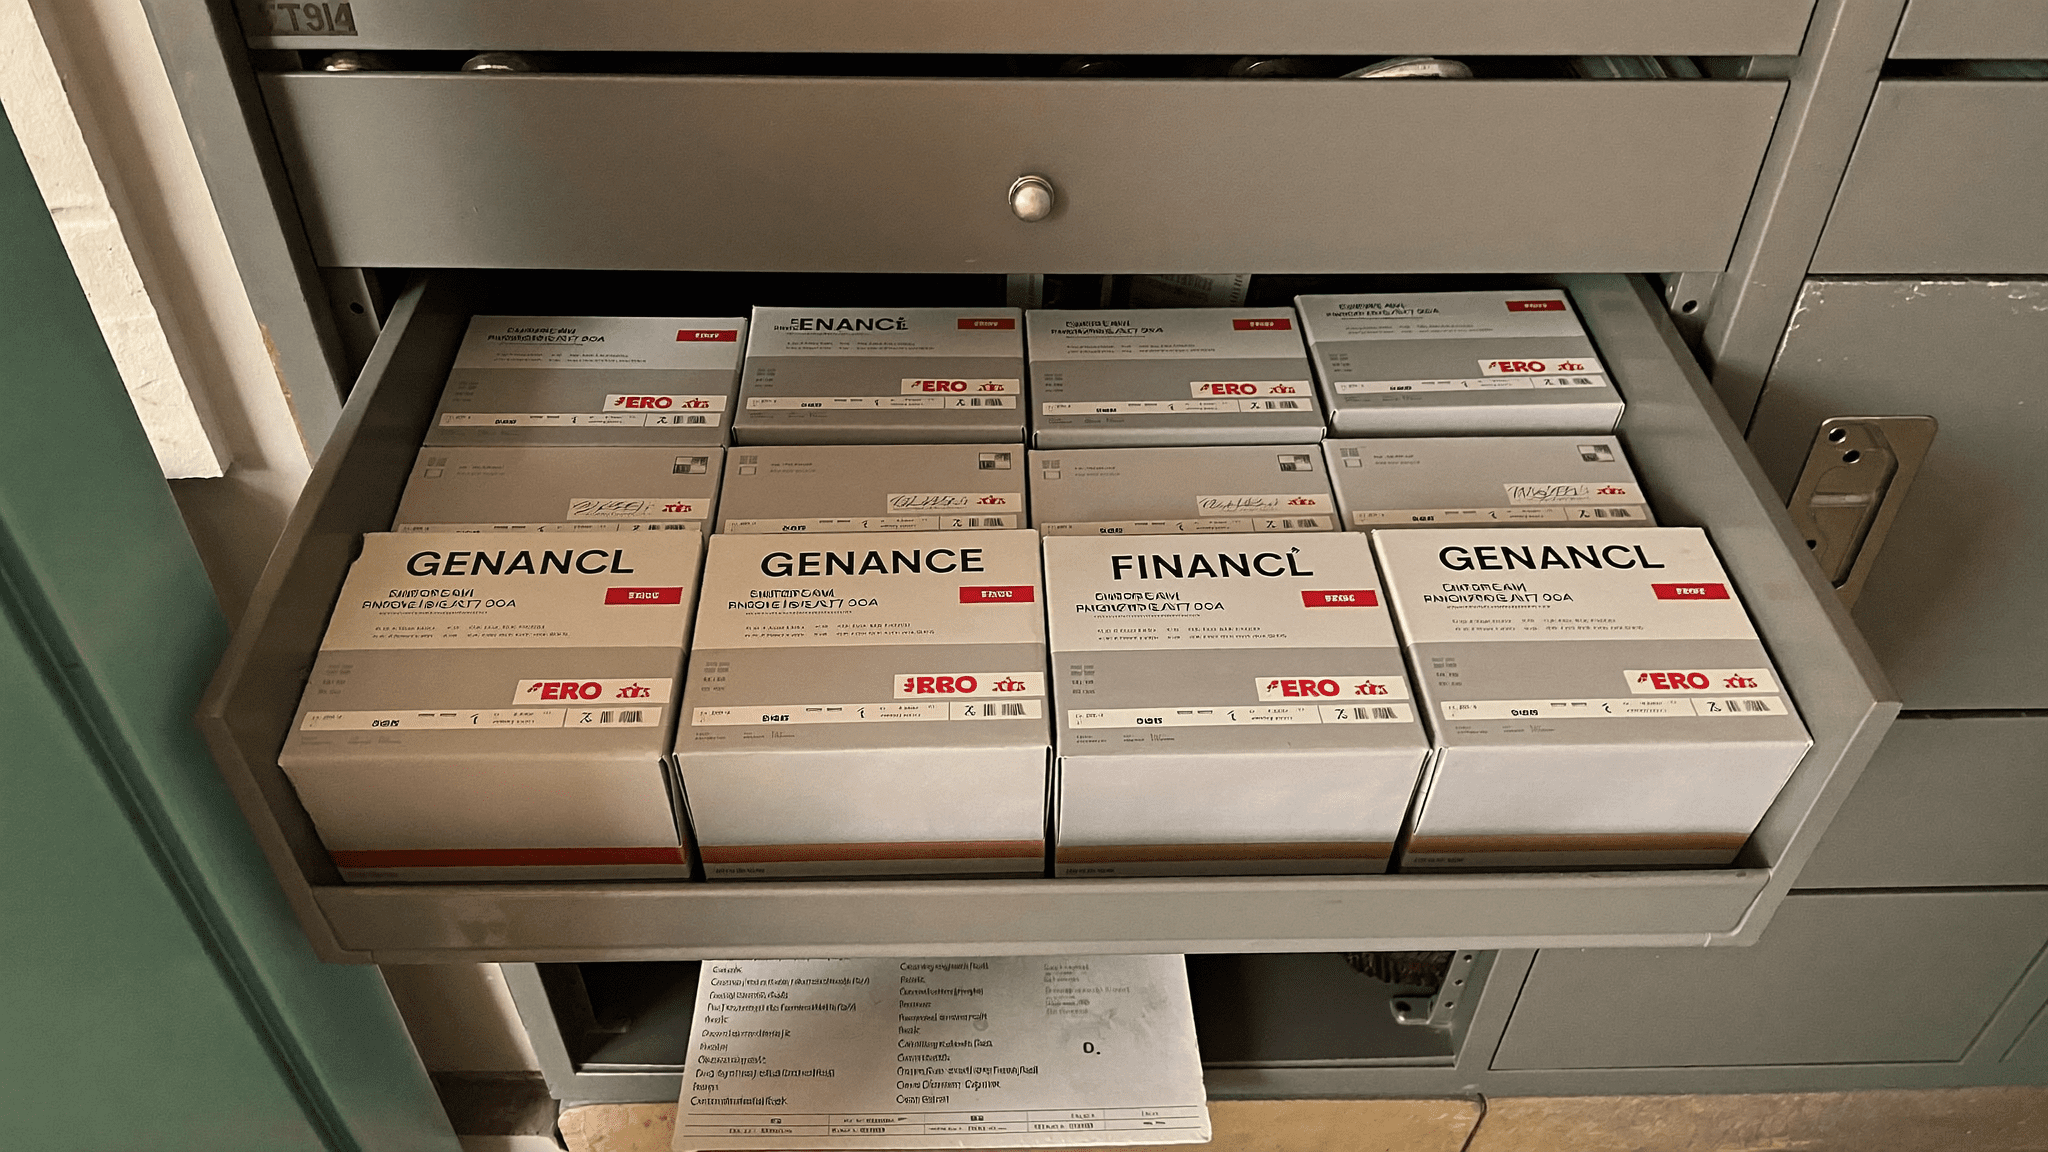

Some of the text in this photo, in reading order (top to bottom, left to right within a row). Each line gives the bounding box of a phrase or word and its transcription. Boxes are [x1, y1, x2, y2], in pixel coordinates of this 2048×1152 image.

[406, 549, 635, 577] GENANCL
[760, 548, 985, 578] GENANCE
[1438, 545, 1666, 571] GENANCL
